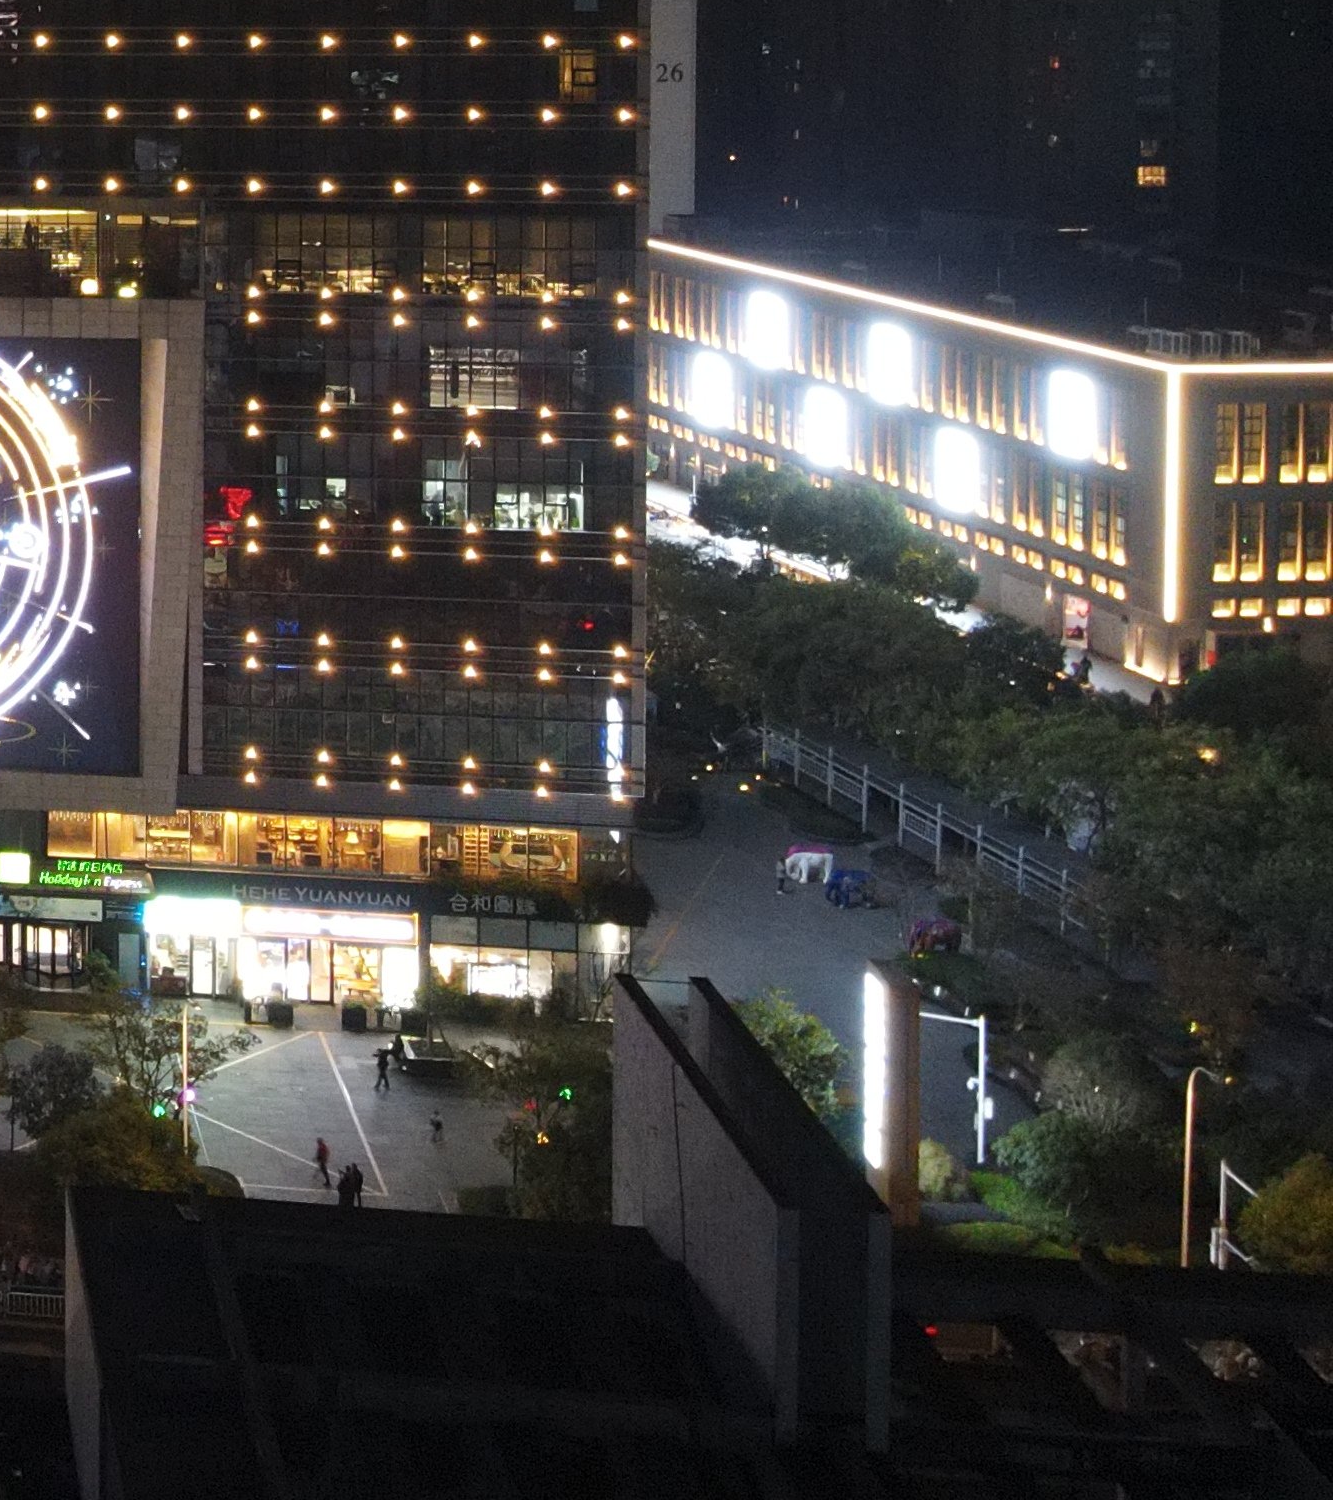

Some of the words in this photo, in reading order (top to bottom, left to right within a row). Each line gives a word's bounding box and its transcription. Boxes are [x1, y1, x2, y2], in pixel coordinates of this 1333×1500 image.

[655, 62, 684, 83] 26
[233, 884, 291, 901] HEHE
[295, 887, 410, 907] YUANYUAN
